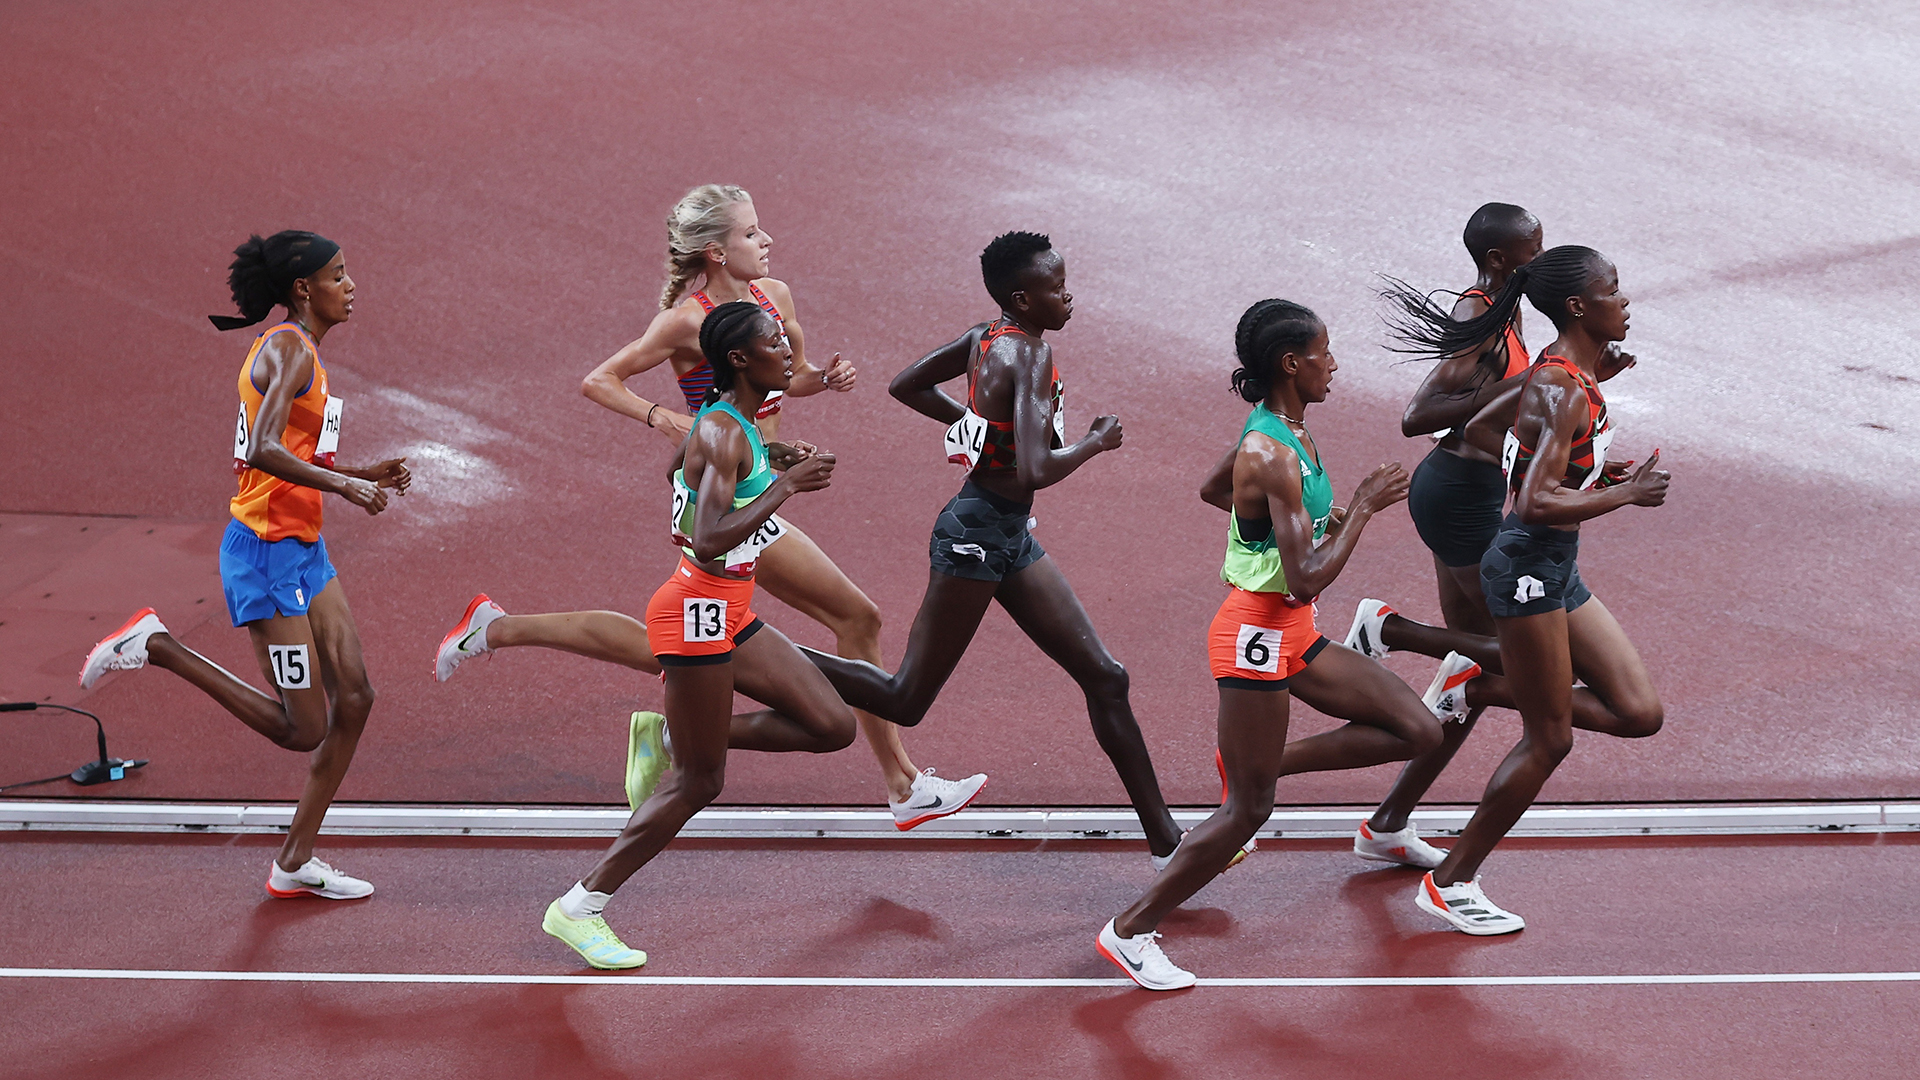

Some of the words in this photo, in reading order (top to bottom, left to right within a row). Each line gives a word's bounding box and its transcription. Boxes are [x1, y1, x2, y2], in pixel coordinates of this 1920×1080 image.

[689, 603, 721, 637] 13
[1245, 632, 1269, 666] 6
[273, 650, 305, 684] 15
